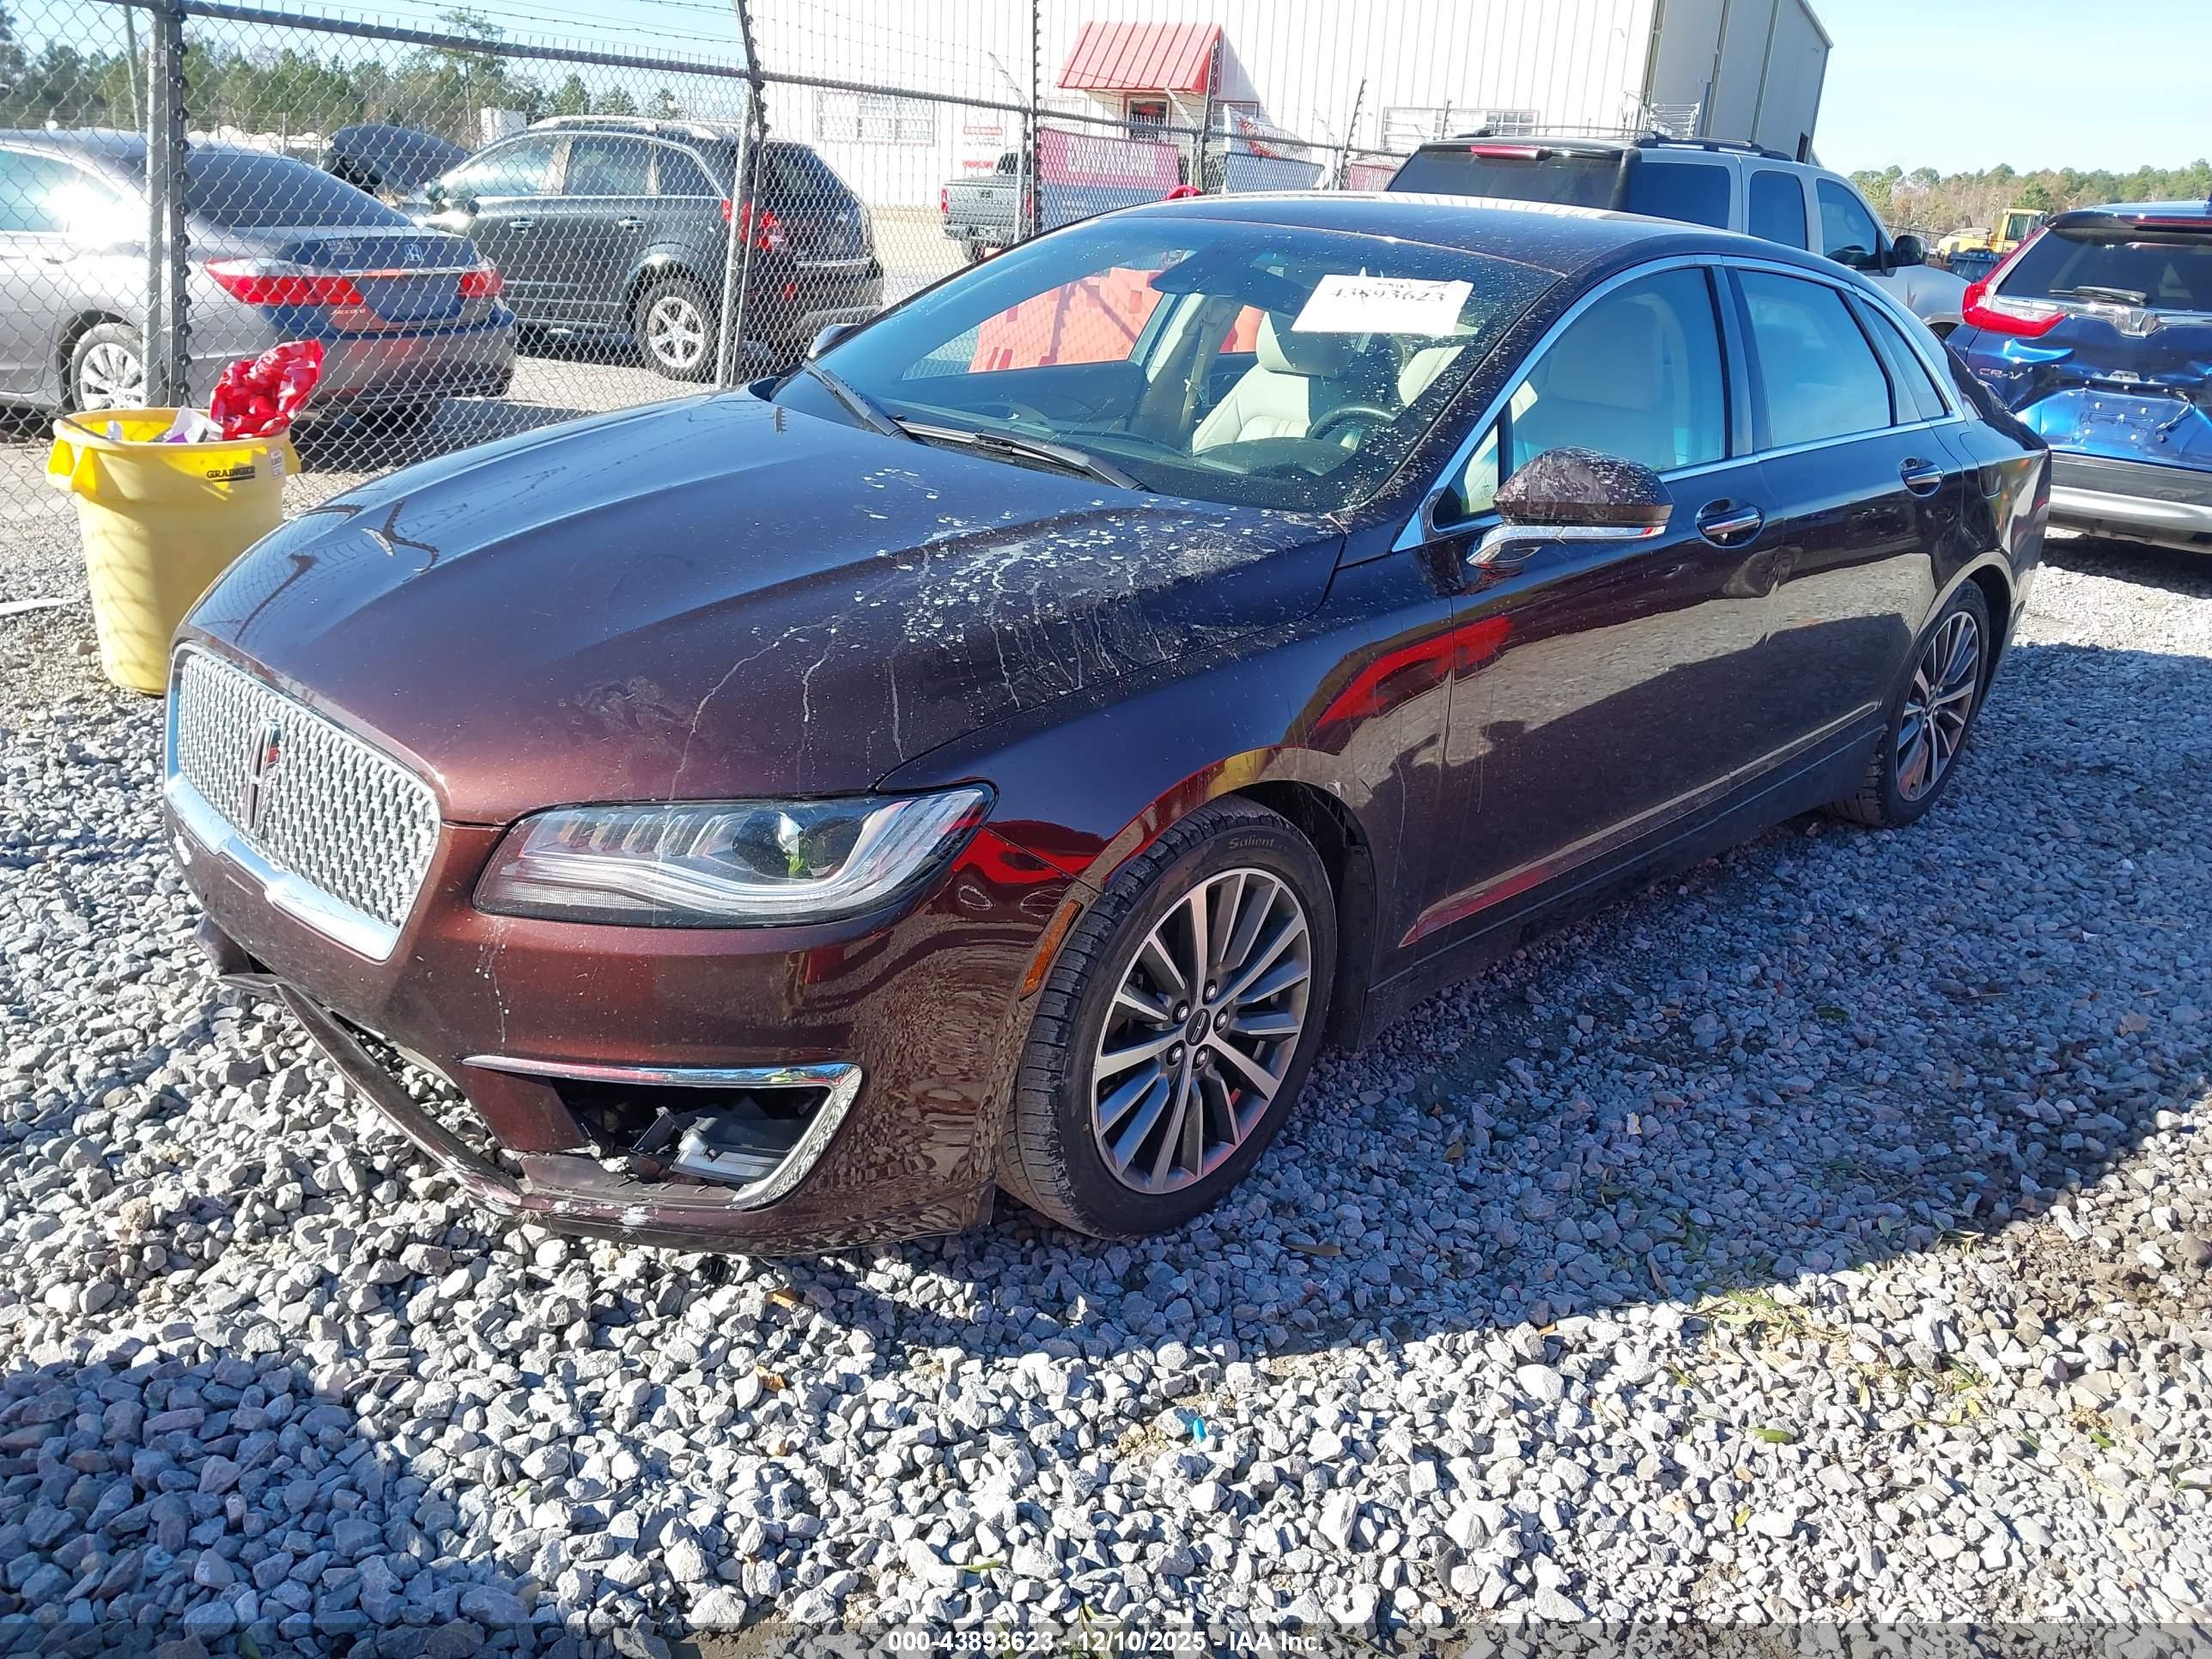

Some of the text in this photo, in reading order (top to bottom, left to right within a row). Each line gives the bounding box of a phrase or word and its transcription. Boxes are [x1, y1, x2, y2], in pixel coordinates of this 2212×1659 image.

[1978, 368, 2025, 380] CR-V
[206, 465, 256, 479] GRAI
[1229, 835, 1275, 849] Salient
